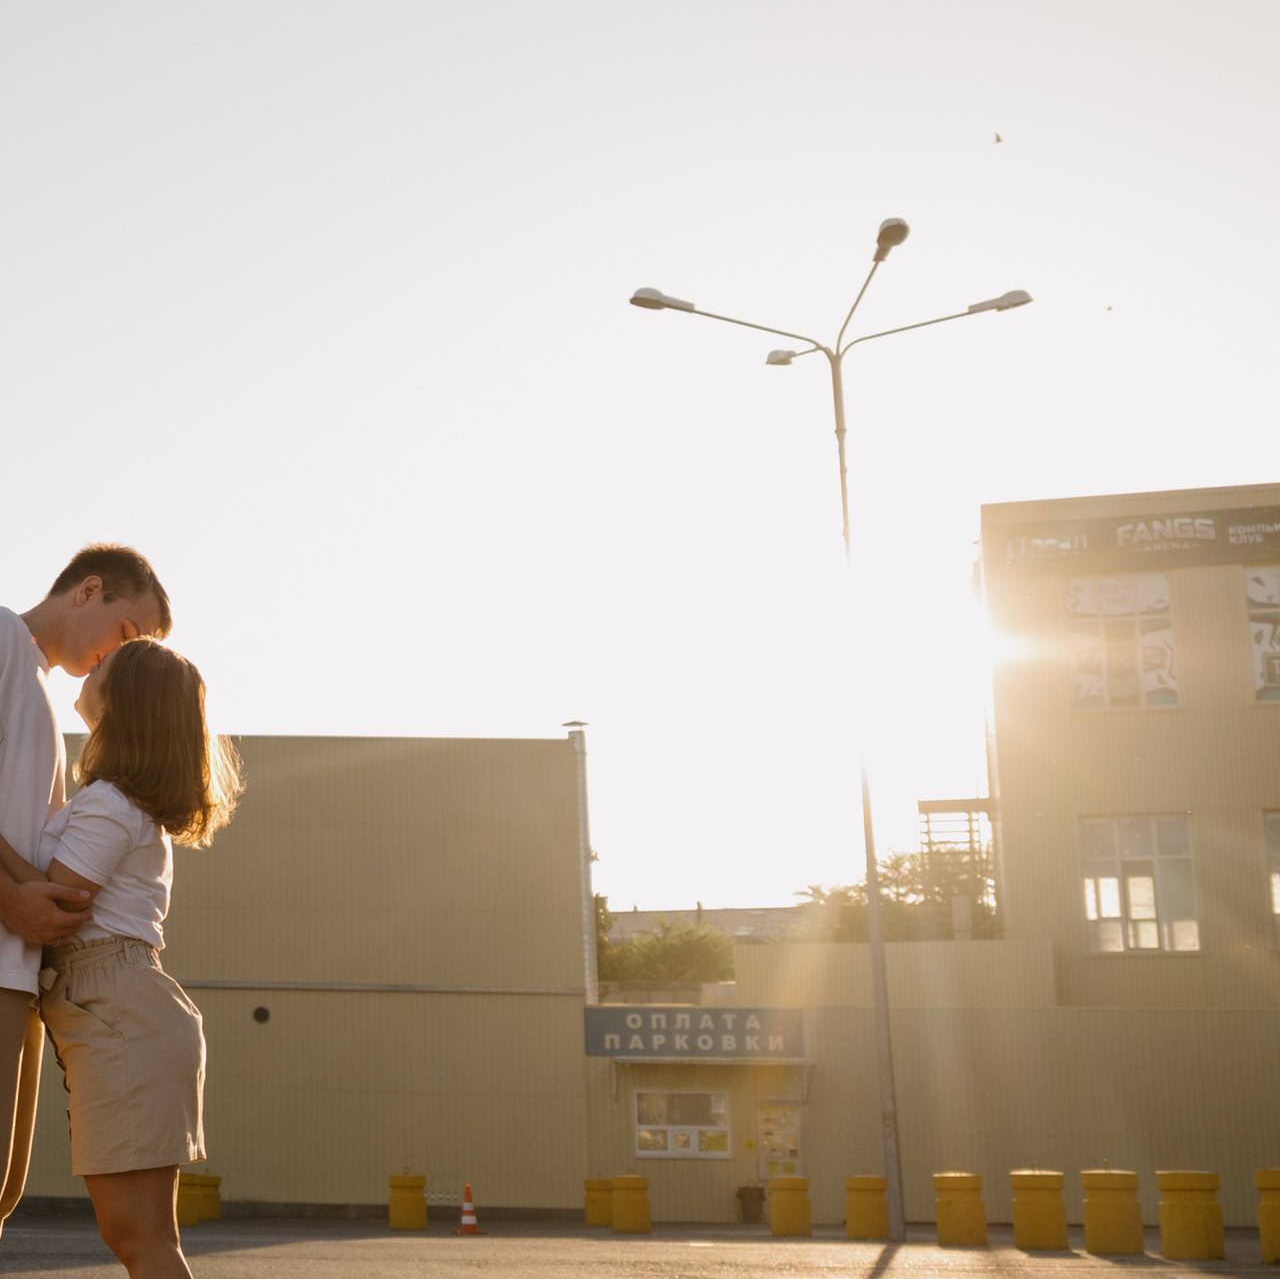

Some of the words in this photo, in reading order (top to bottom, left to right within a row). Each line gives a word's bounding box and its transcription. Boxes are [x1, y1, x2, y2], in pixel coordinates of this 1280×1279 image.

[1116, 518, 1216, 547] FANGS
[1229, 533, 1264, 544] КЛУБ
[626, 1013, 761, 1030] ОПЛАТА
[605, 1034, 785, 1051] ПАРКОВКИ
